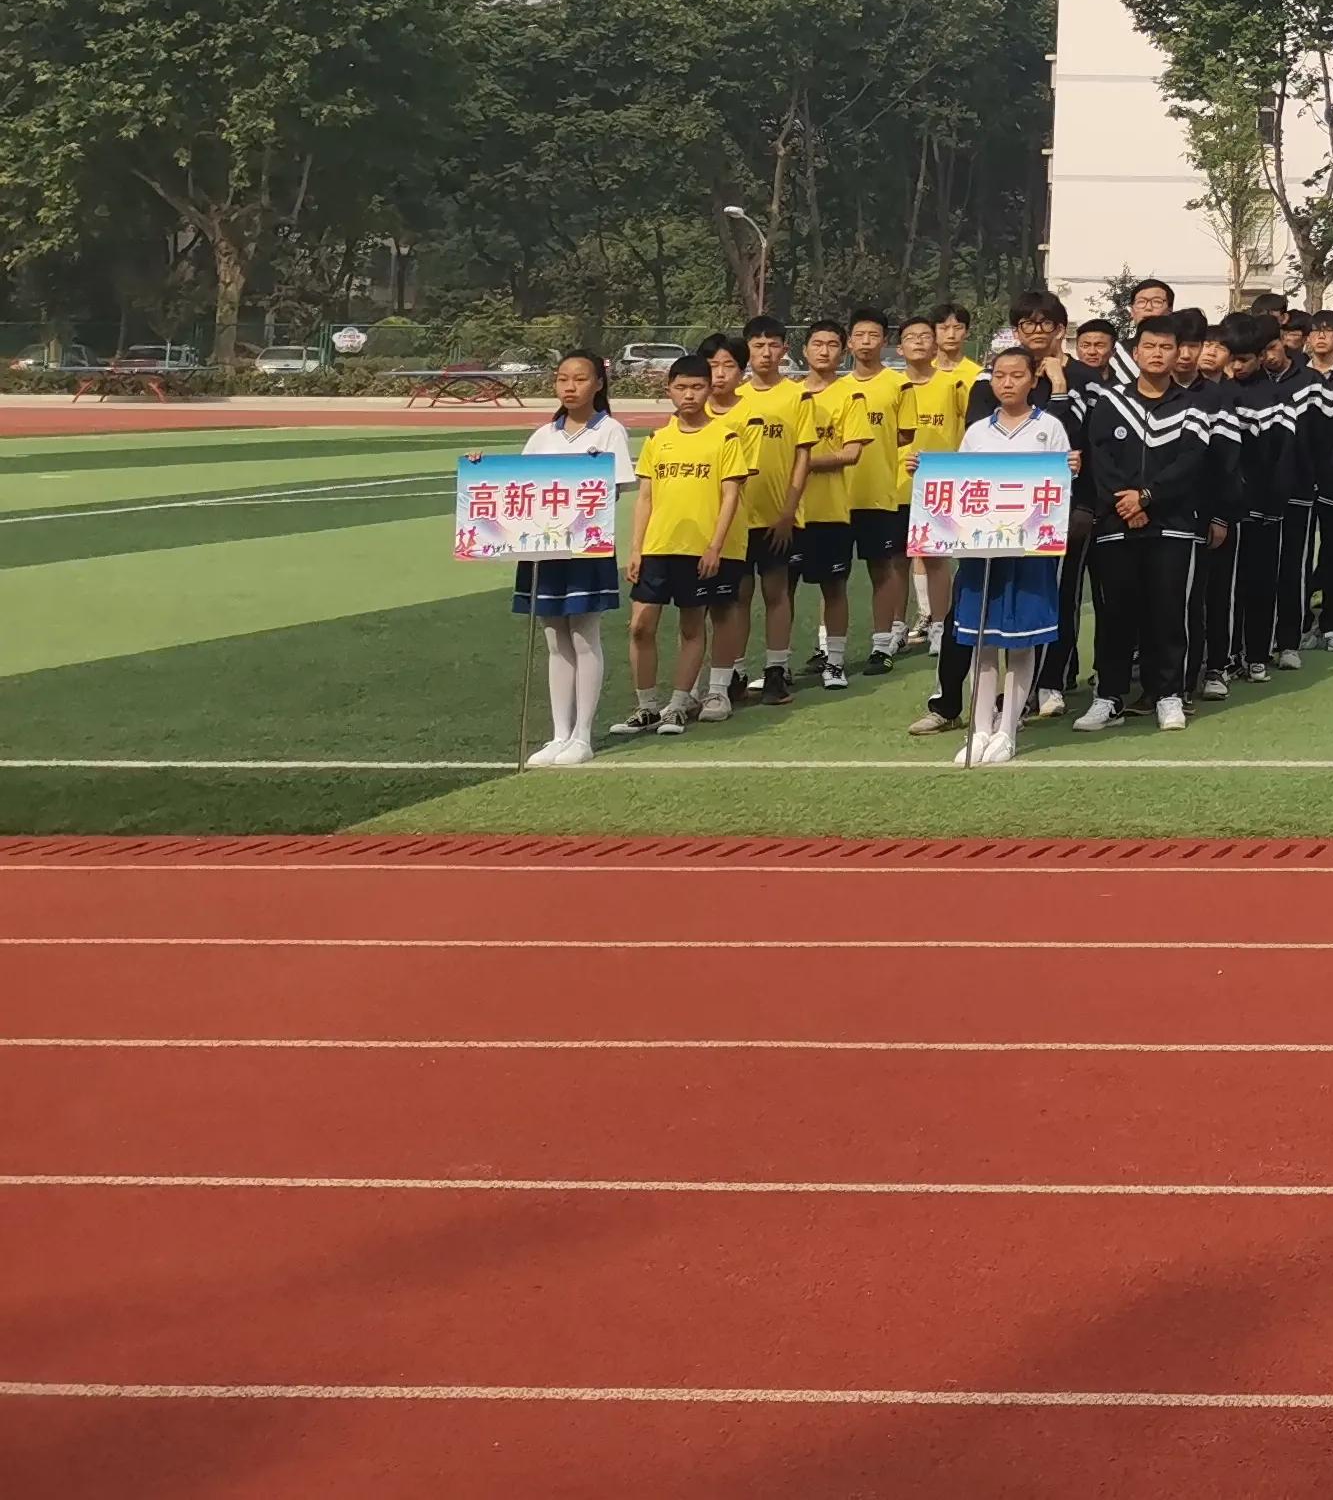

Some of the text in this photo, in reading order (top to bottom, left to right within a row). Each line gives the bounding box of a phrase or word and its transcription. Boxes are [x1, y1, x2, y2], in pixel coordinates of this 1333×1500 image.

[654, 462, 711, 479] 渭河学校
[469, 480, 608, 519] 高新中学
[923, 479, 1063, 517] 明德二中
